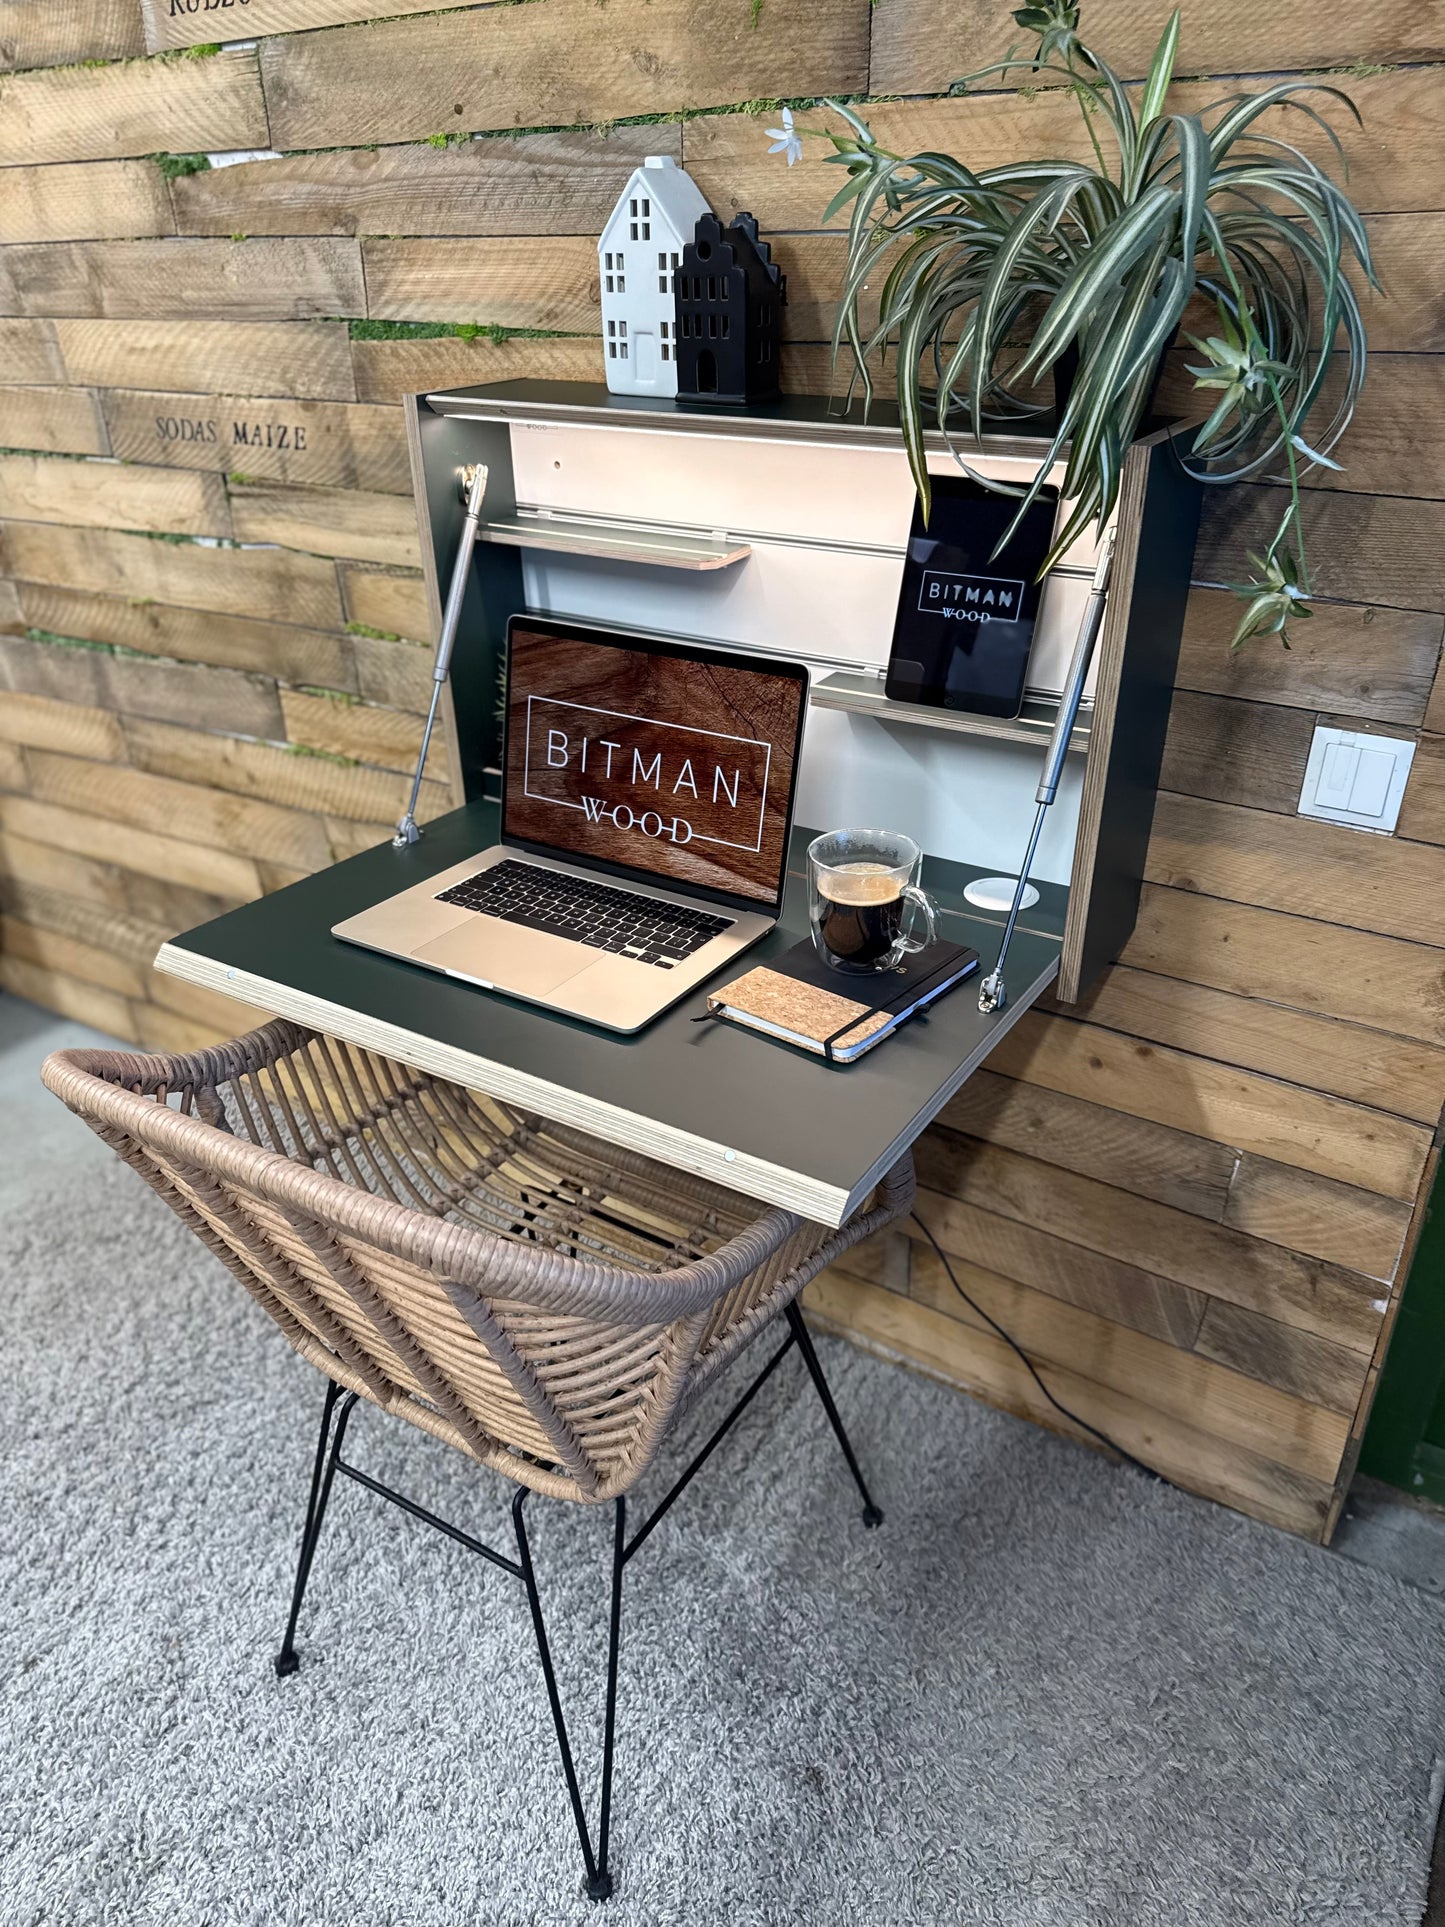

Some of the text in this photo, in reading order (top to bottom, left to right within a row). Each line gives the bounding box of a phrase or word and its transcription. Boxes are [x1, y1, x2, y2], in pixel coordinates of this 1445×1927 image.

[155, 416, 308, 451] SODAS MAIZE
[929, 582, 1013, 608] BITMAN
[943, 607, 991, 623] WOOD
[547, 729, 740, 808] BITMAN
[581, 795, 693, 844] WOOD
